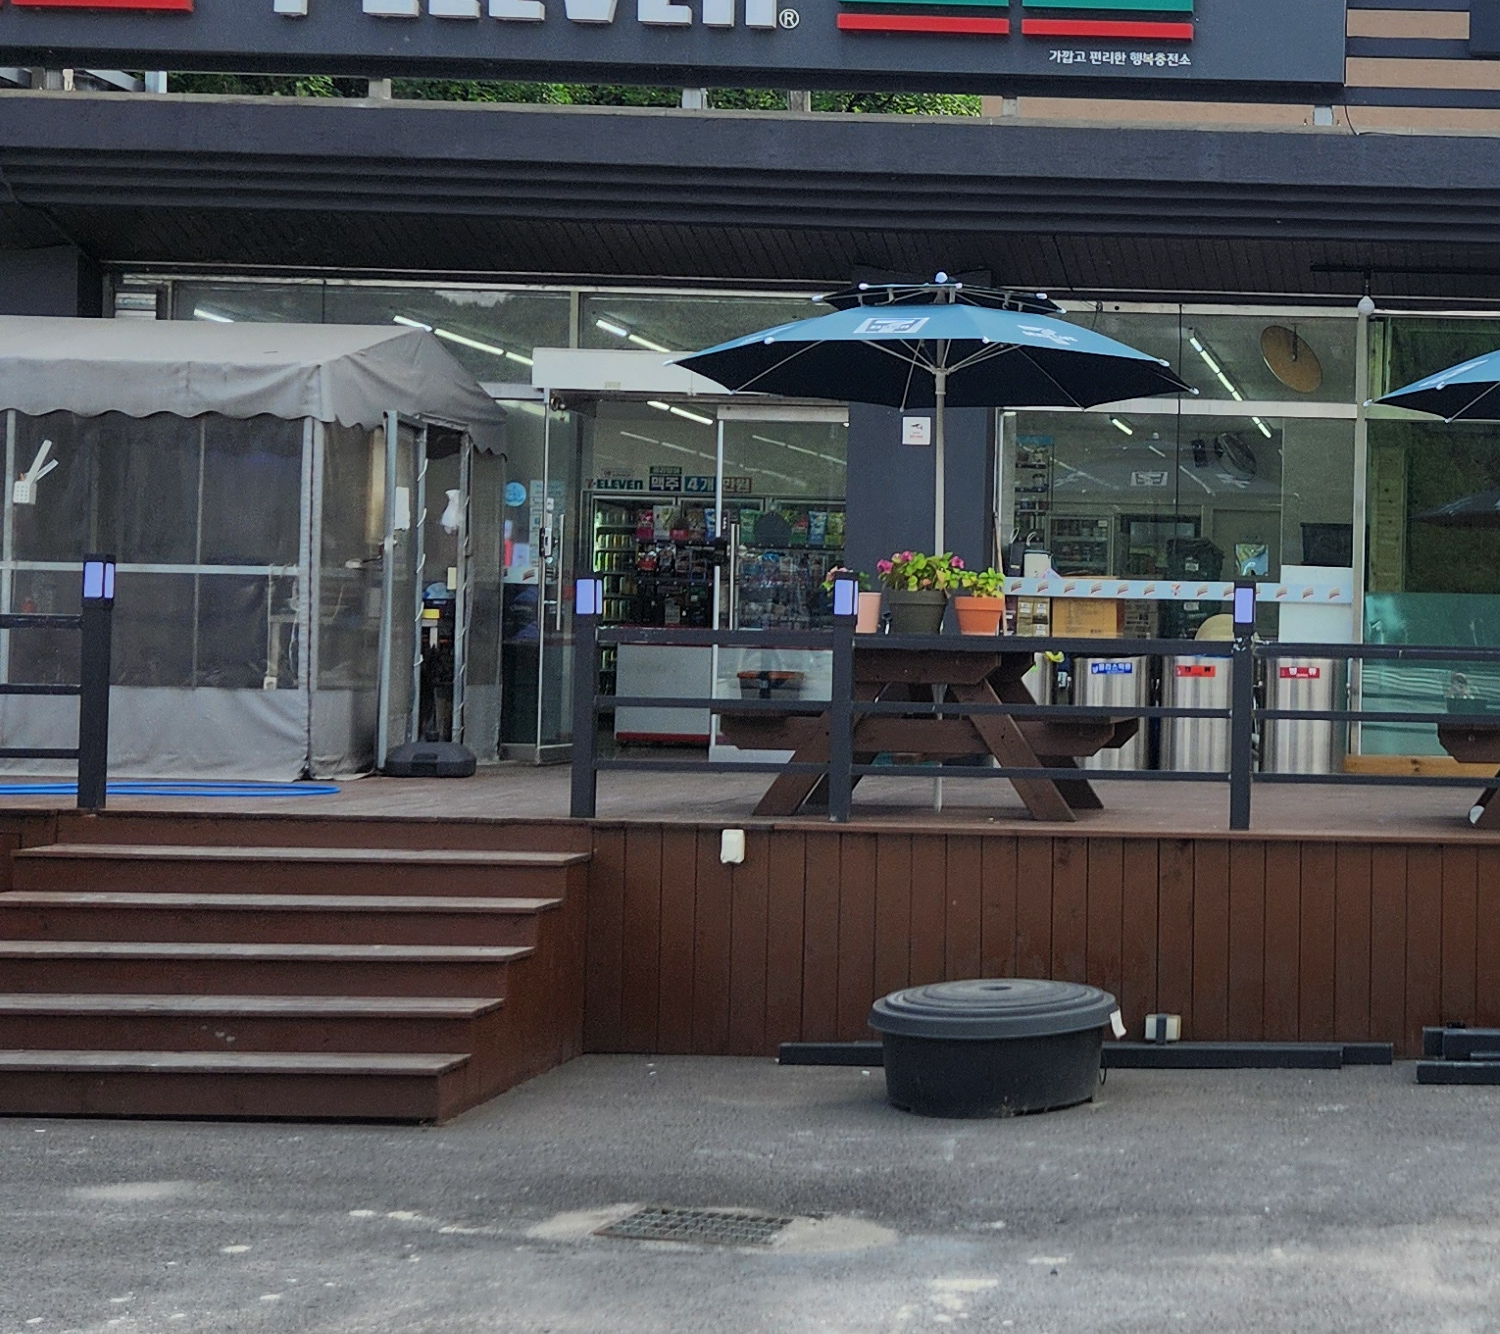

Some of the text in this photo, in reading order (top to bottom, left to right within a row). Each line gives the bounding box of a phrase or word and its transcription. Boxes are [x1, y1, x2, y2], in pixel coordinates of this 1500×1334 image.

[1049, 50, 1192, 67] 가깝고 편리한 행복충전소
